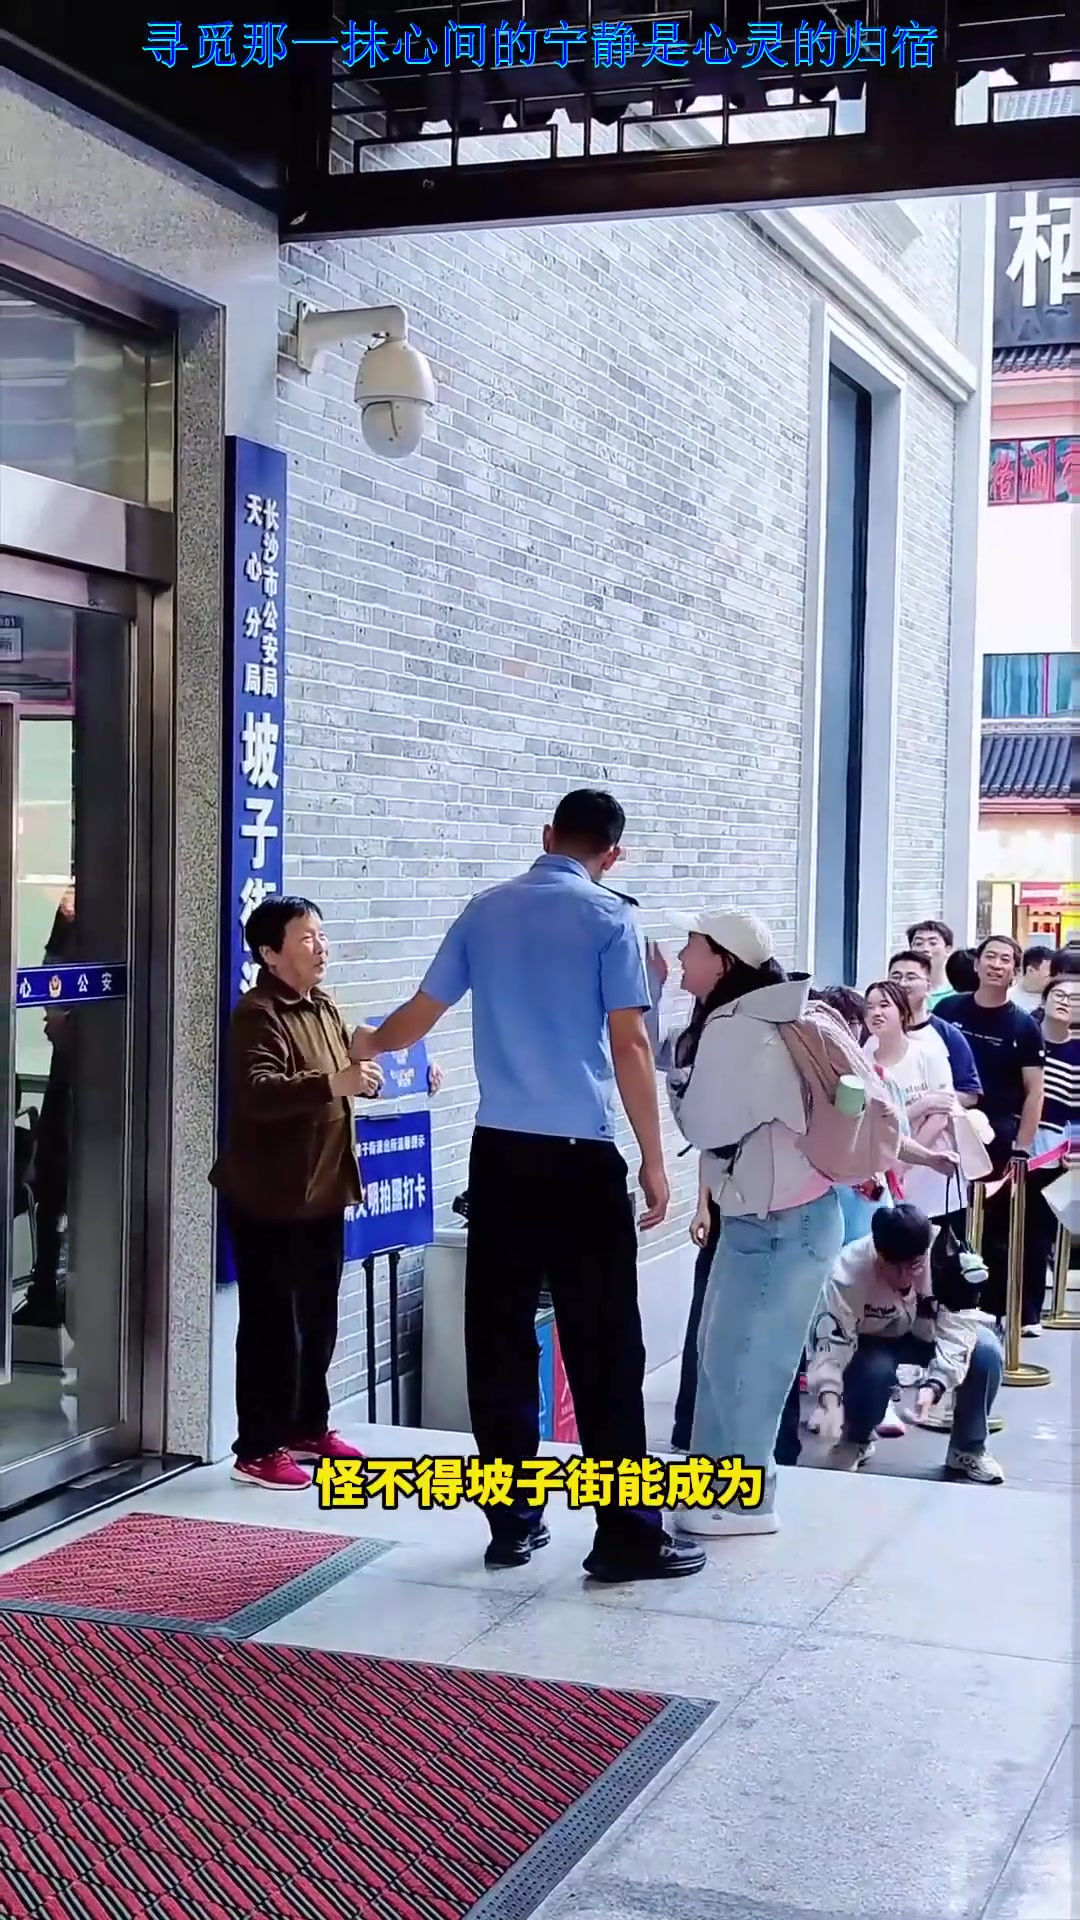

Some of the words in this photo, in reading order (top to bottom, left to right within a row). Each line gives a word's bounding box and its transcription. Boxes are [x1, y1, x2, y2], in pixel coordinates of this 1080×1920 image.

[243, 493, 263, 696] 天心分局
[261, 498, 280, 698] 长沙市公安局
[239, 711, 280, 994] 坡子
[77, 973, 112, 992] 公安
